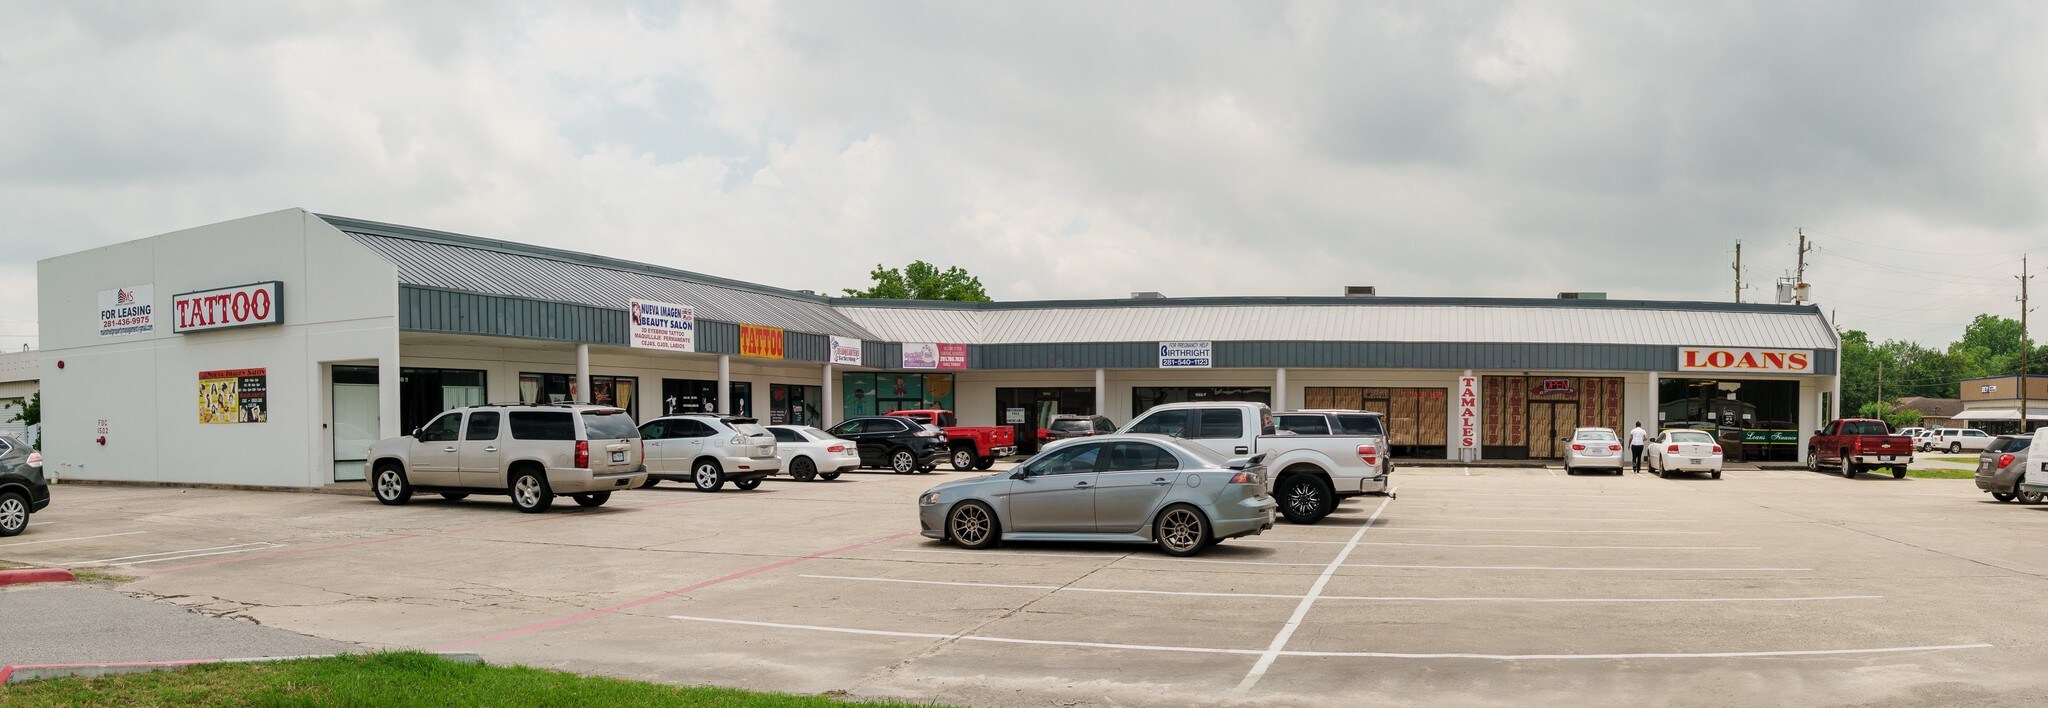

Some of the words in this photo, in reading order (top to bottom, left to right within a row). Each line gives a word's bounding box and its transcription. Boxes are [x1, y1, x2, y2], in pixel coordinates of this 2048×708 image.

[101, 309, 116, 320] FOR
[117, 304, 152, 318] LEASING
[176, 288, 271, 328] TATTOO
[641, 303, 660, 316] NUEVA
[660, 306, 682, 318] IMAGEN
[103, 315, 150, 328] 281-436-9975
[641, 317, 669, 328] BEAUTY
[670, 320, 693, 331] SALON
[741, 326, 783, 357] TATTOO
[1161, 345, 1209, 356] BIRTHRIGHT
[1684, 350, 1808, 371] LOANS
[1461, 378, 1476, 447] TAMALES
[1746, 432, 1766, 441] Loans
[1770, 432, 1797, 441] Finance
